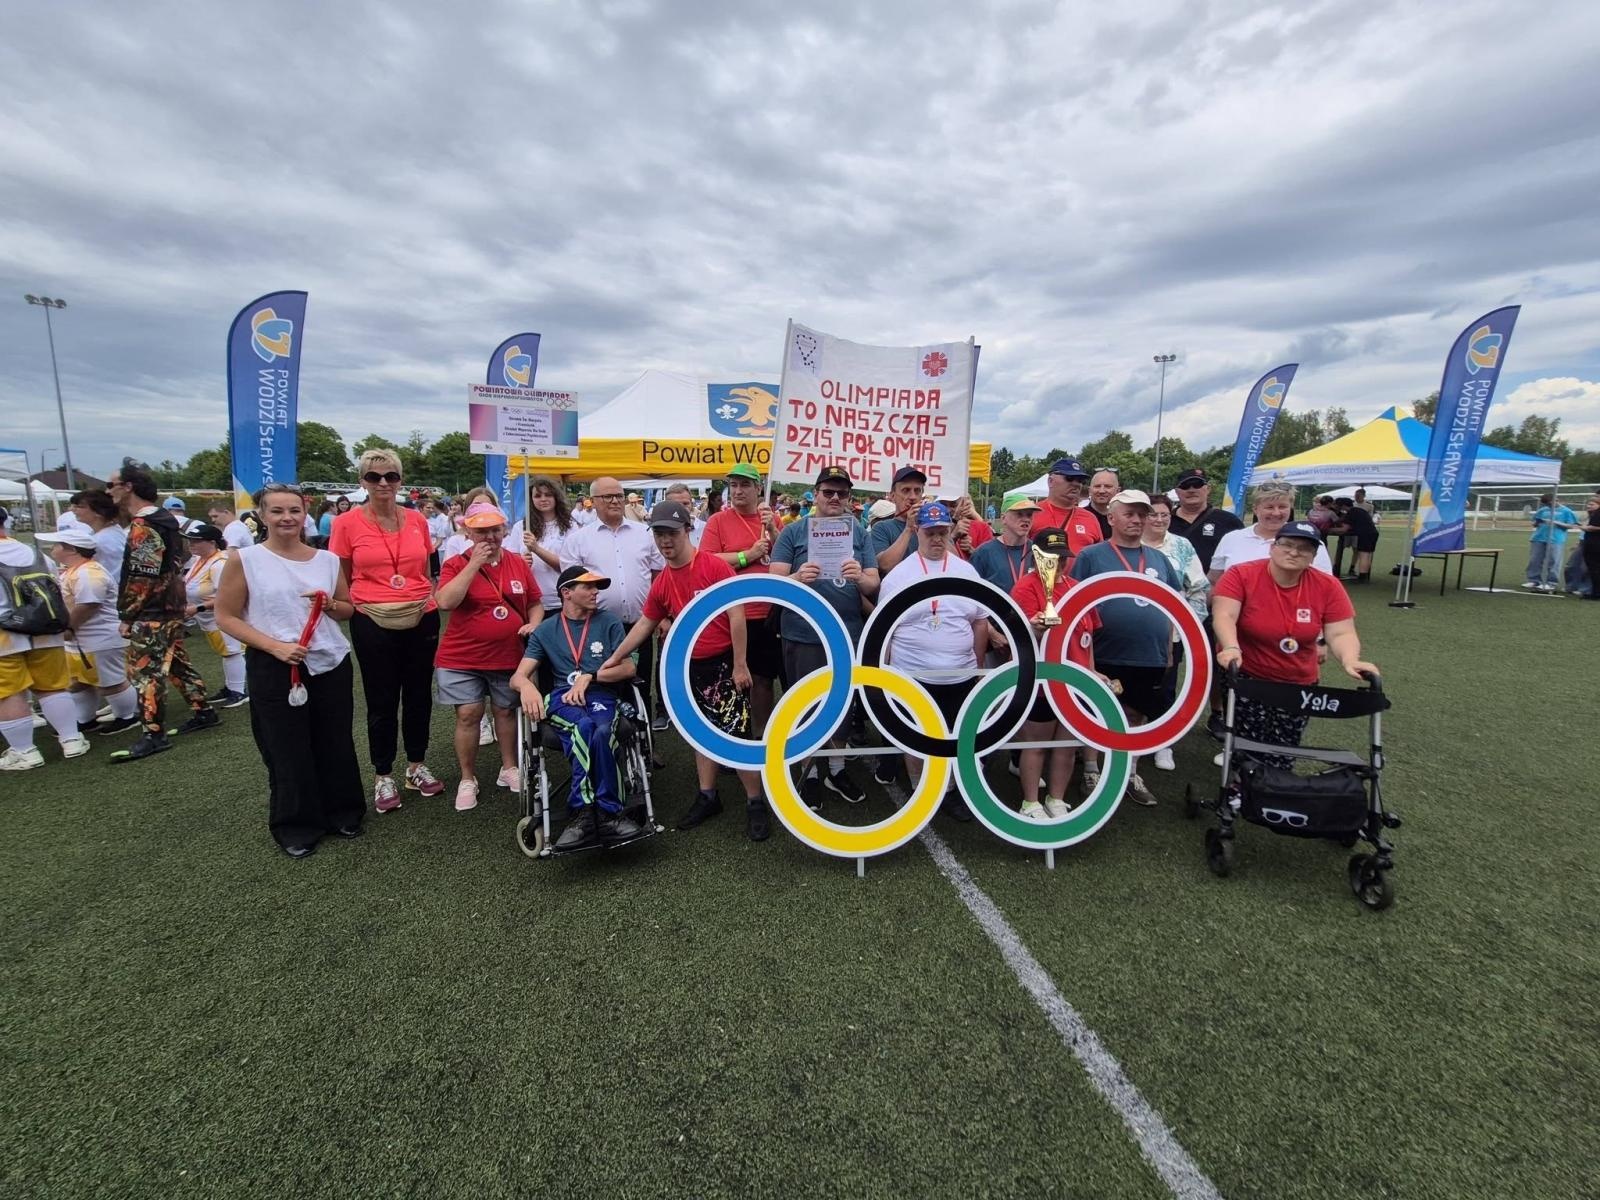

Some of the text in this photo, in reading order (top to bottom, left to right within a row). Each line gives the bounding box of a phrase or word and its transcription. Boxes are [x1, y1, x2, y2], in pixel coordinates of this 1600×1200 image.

[276, 369, 289, 429] POWIAT
[788, 399, 817, 420] TO
[820, 379, 941, 410] OLIMPIADA
[1468, 379, 1491, 433] POWIAT
[258, 368, 276, 486] WODZISŁAWS
[786, 424, 935, 462] DZIŚ POŁOMIA
[1440, 380, 1476, 502] WODZISŁAWSKI
[642, 440, 771, 464] Powiat Wo
[1301, 690, 1340, 712] Yola
